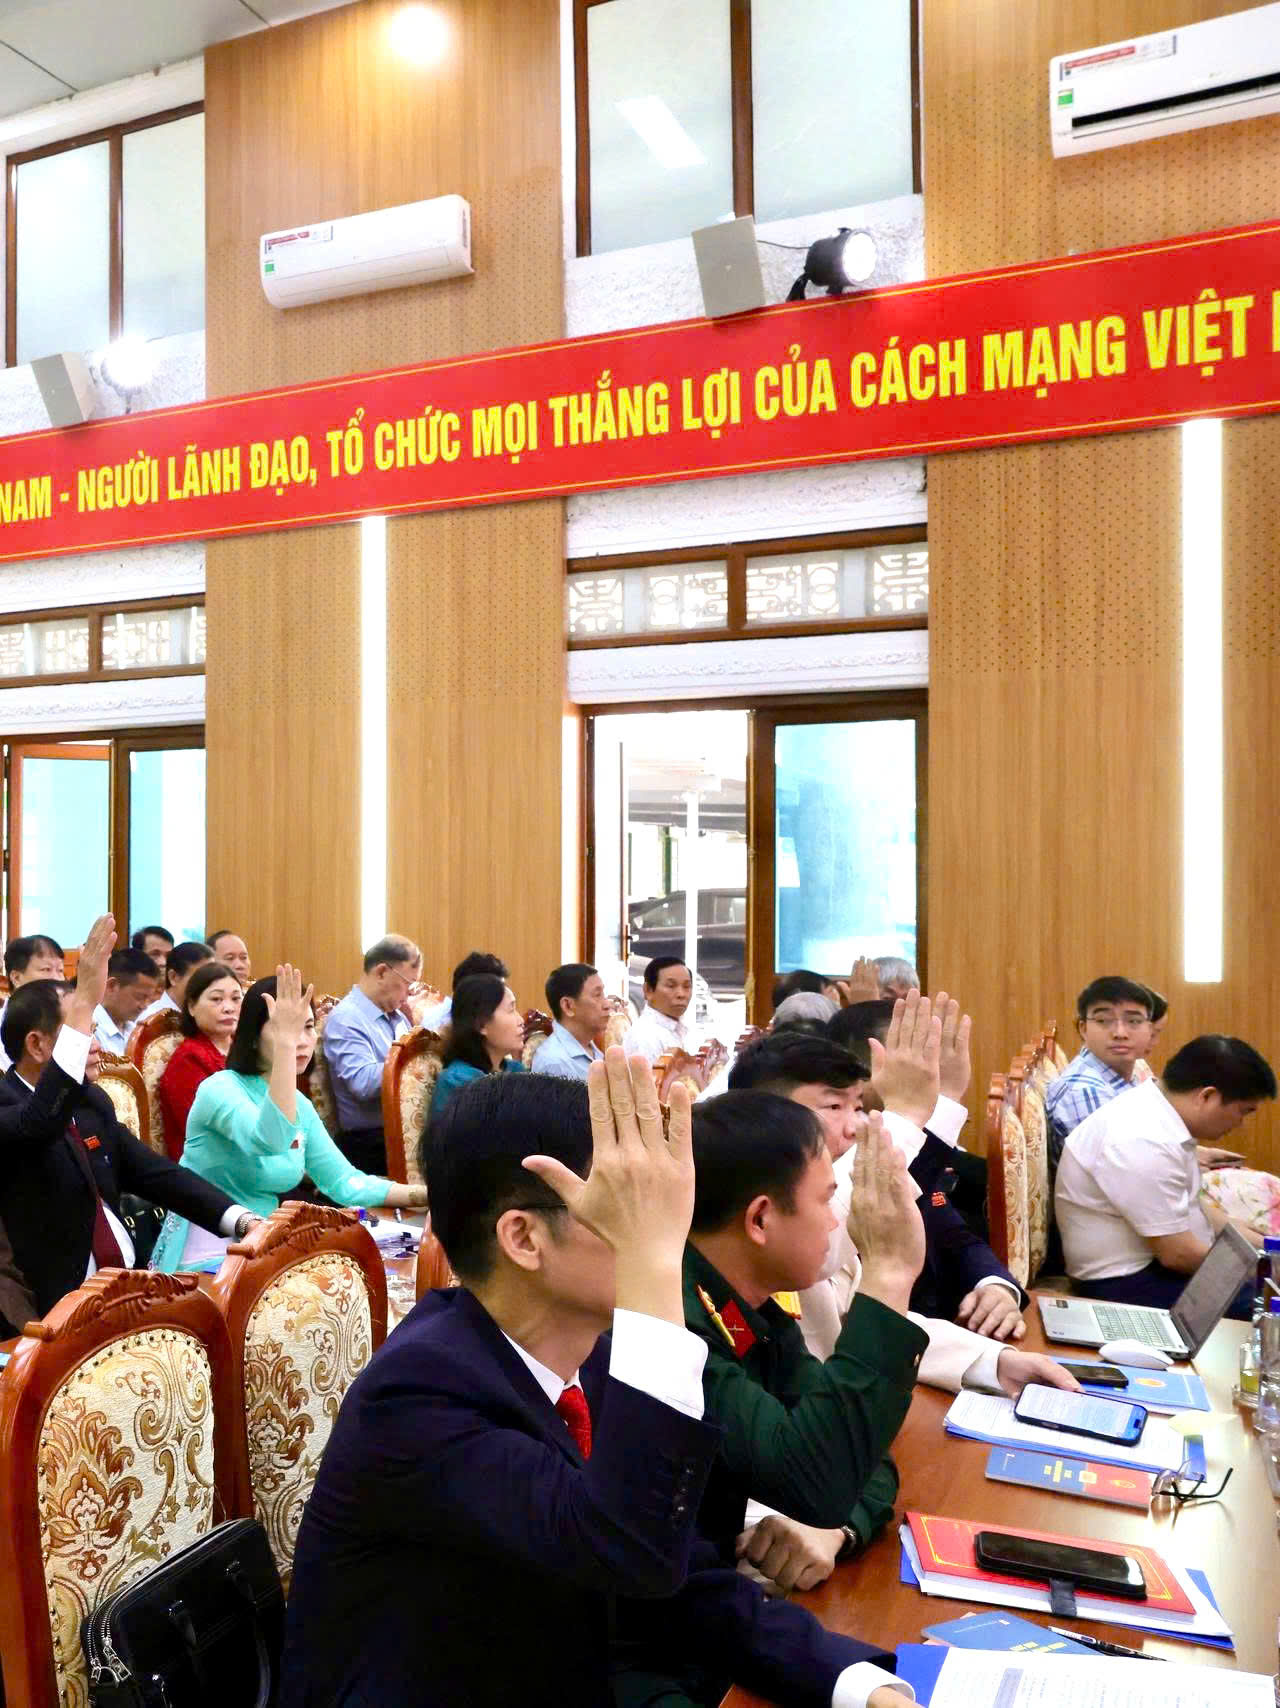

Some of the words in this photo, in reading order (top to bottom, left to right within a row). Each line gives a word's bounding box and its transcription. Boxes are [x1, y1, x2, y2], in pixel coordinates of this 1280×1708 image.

[78, 450, 159, 513] NGƯỜI
[168, 445, 241, 501] LÃNH
[249, 436, 317, 496] ĐẠO,
[326, 407, 365, 478] TỔ
[374, 405, 461, 471] CHỨC
[471, 400, 538, 465] MỌI
[548, 371, 670, 447] THẮNG
[682, 367, 741, 439] LỢI
[754, 343, 837, 421] CỦA
[850, 335, 967, 408] CÁCH
[983, 315, 1127, 398] MẠNG
[1142, 287, 1254, 377] VIỆT
